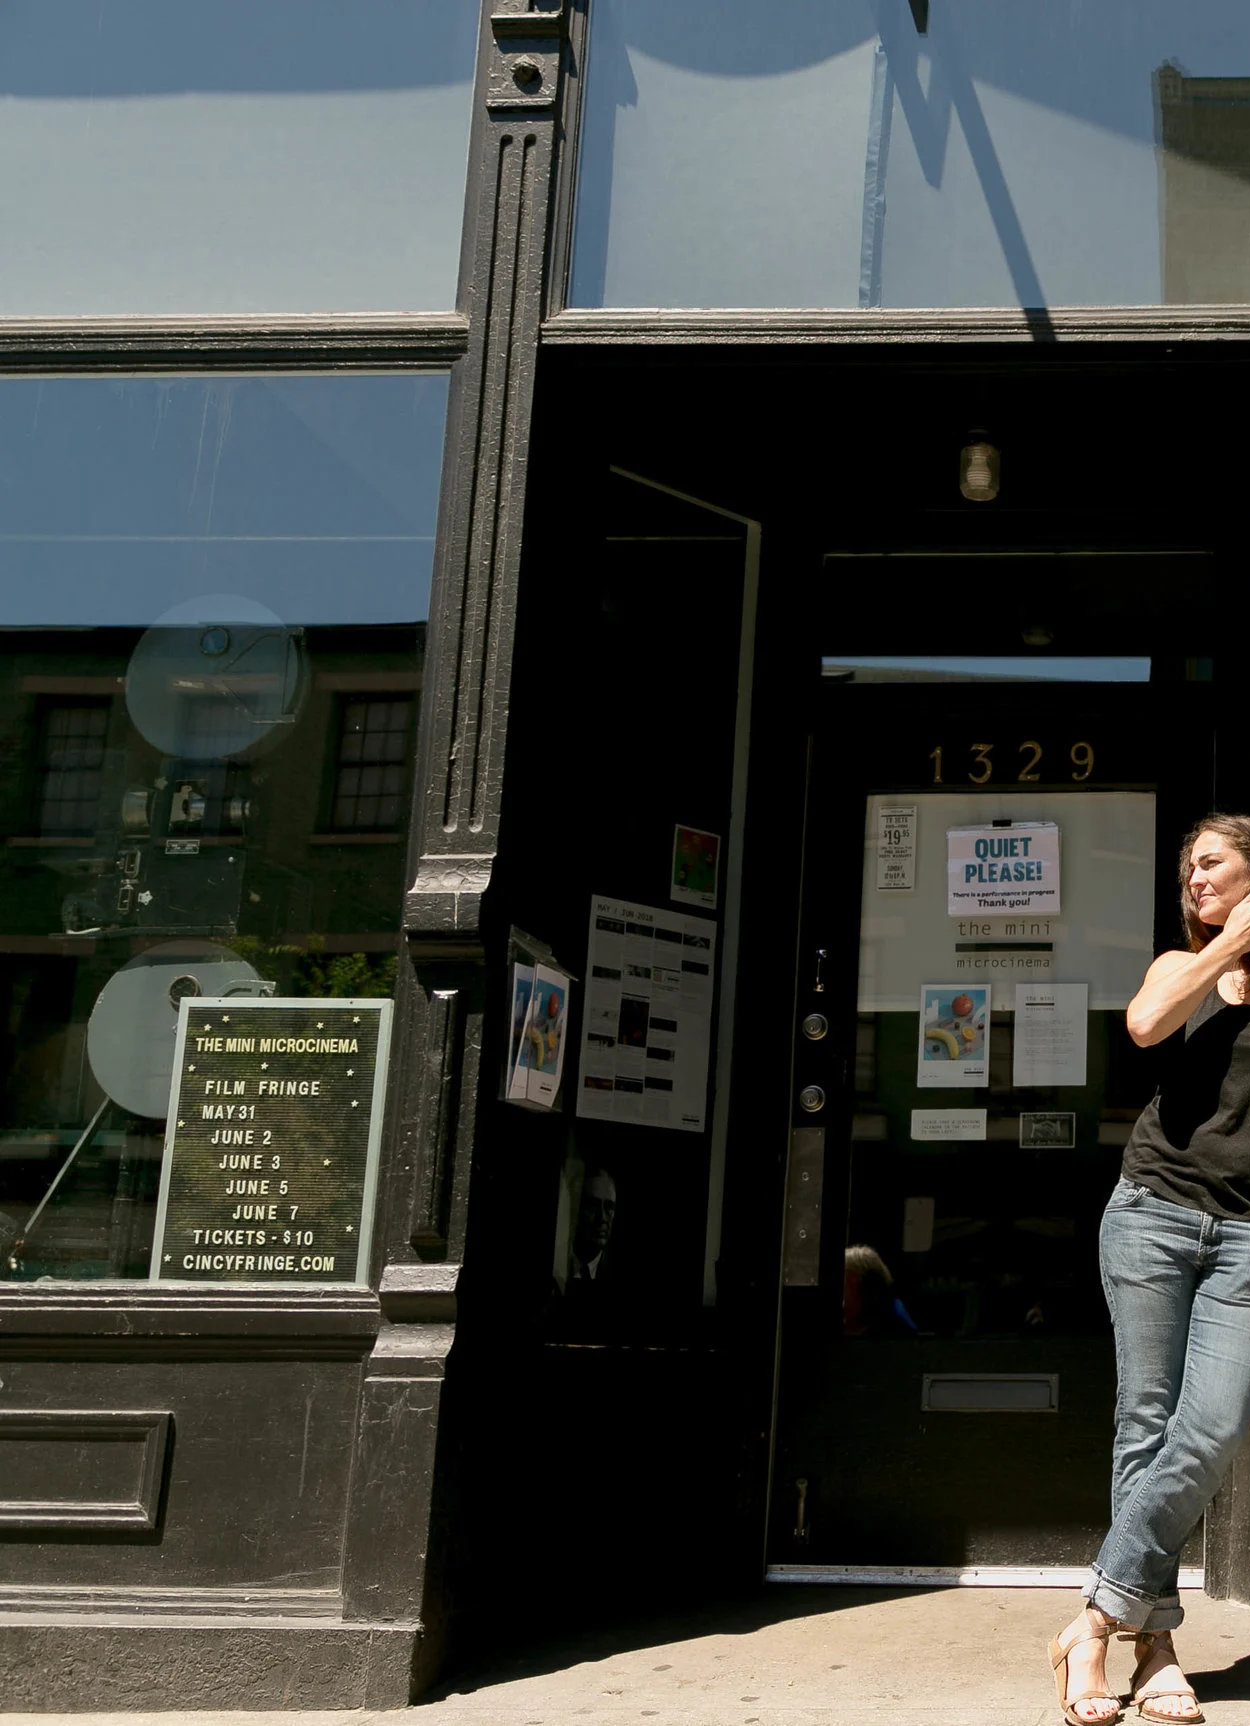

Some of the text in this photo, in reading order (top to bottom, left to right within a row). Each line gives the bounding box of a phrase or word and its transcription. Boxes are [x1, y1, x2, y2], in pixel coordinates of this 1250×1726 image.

[929, 740, 1095, 784] 1329
[975, 837, 1032, 862] QUIET
[965, 861, 1042, 883] PLEASE!
[981, 890, 1021, 898] performance
[1028, 889, 1055, 897] progress
[597, 903, 610, 913] MAY
[977, 897, 1031, 908] Thank you!
[958, 920, 1051, 936] the mini
[956, 958, 1050, 968] microcinema
[196, 1038, 359, 1053] THE MINI MICROCINEMA
[205, 1081, 321, 1096] FILM FRINGE
[202, 1105, 256, 1120] MAY 31
[211, 1130, 272, 1145] JUNE 2
[219, 1155, 281, 1170] JUNE 3
[226, 1180, 289, 1195] JUNE 5
[232, 1205, 299, 1220] JUNE 7
[193, 1229, 266, 1245] TICKETS
[283, 1230, 314, 1246] $10
[183, 1255, 335, 1272] CINCYFRINGE.COM
